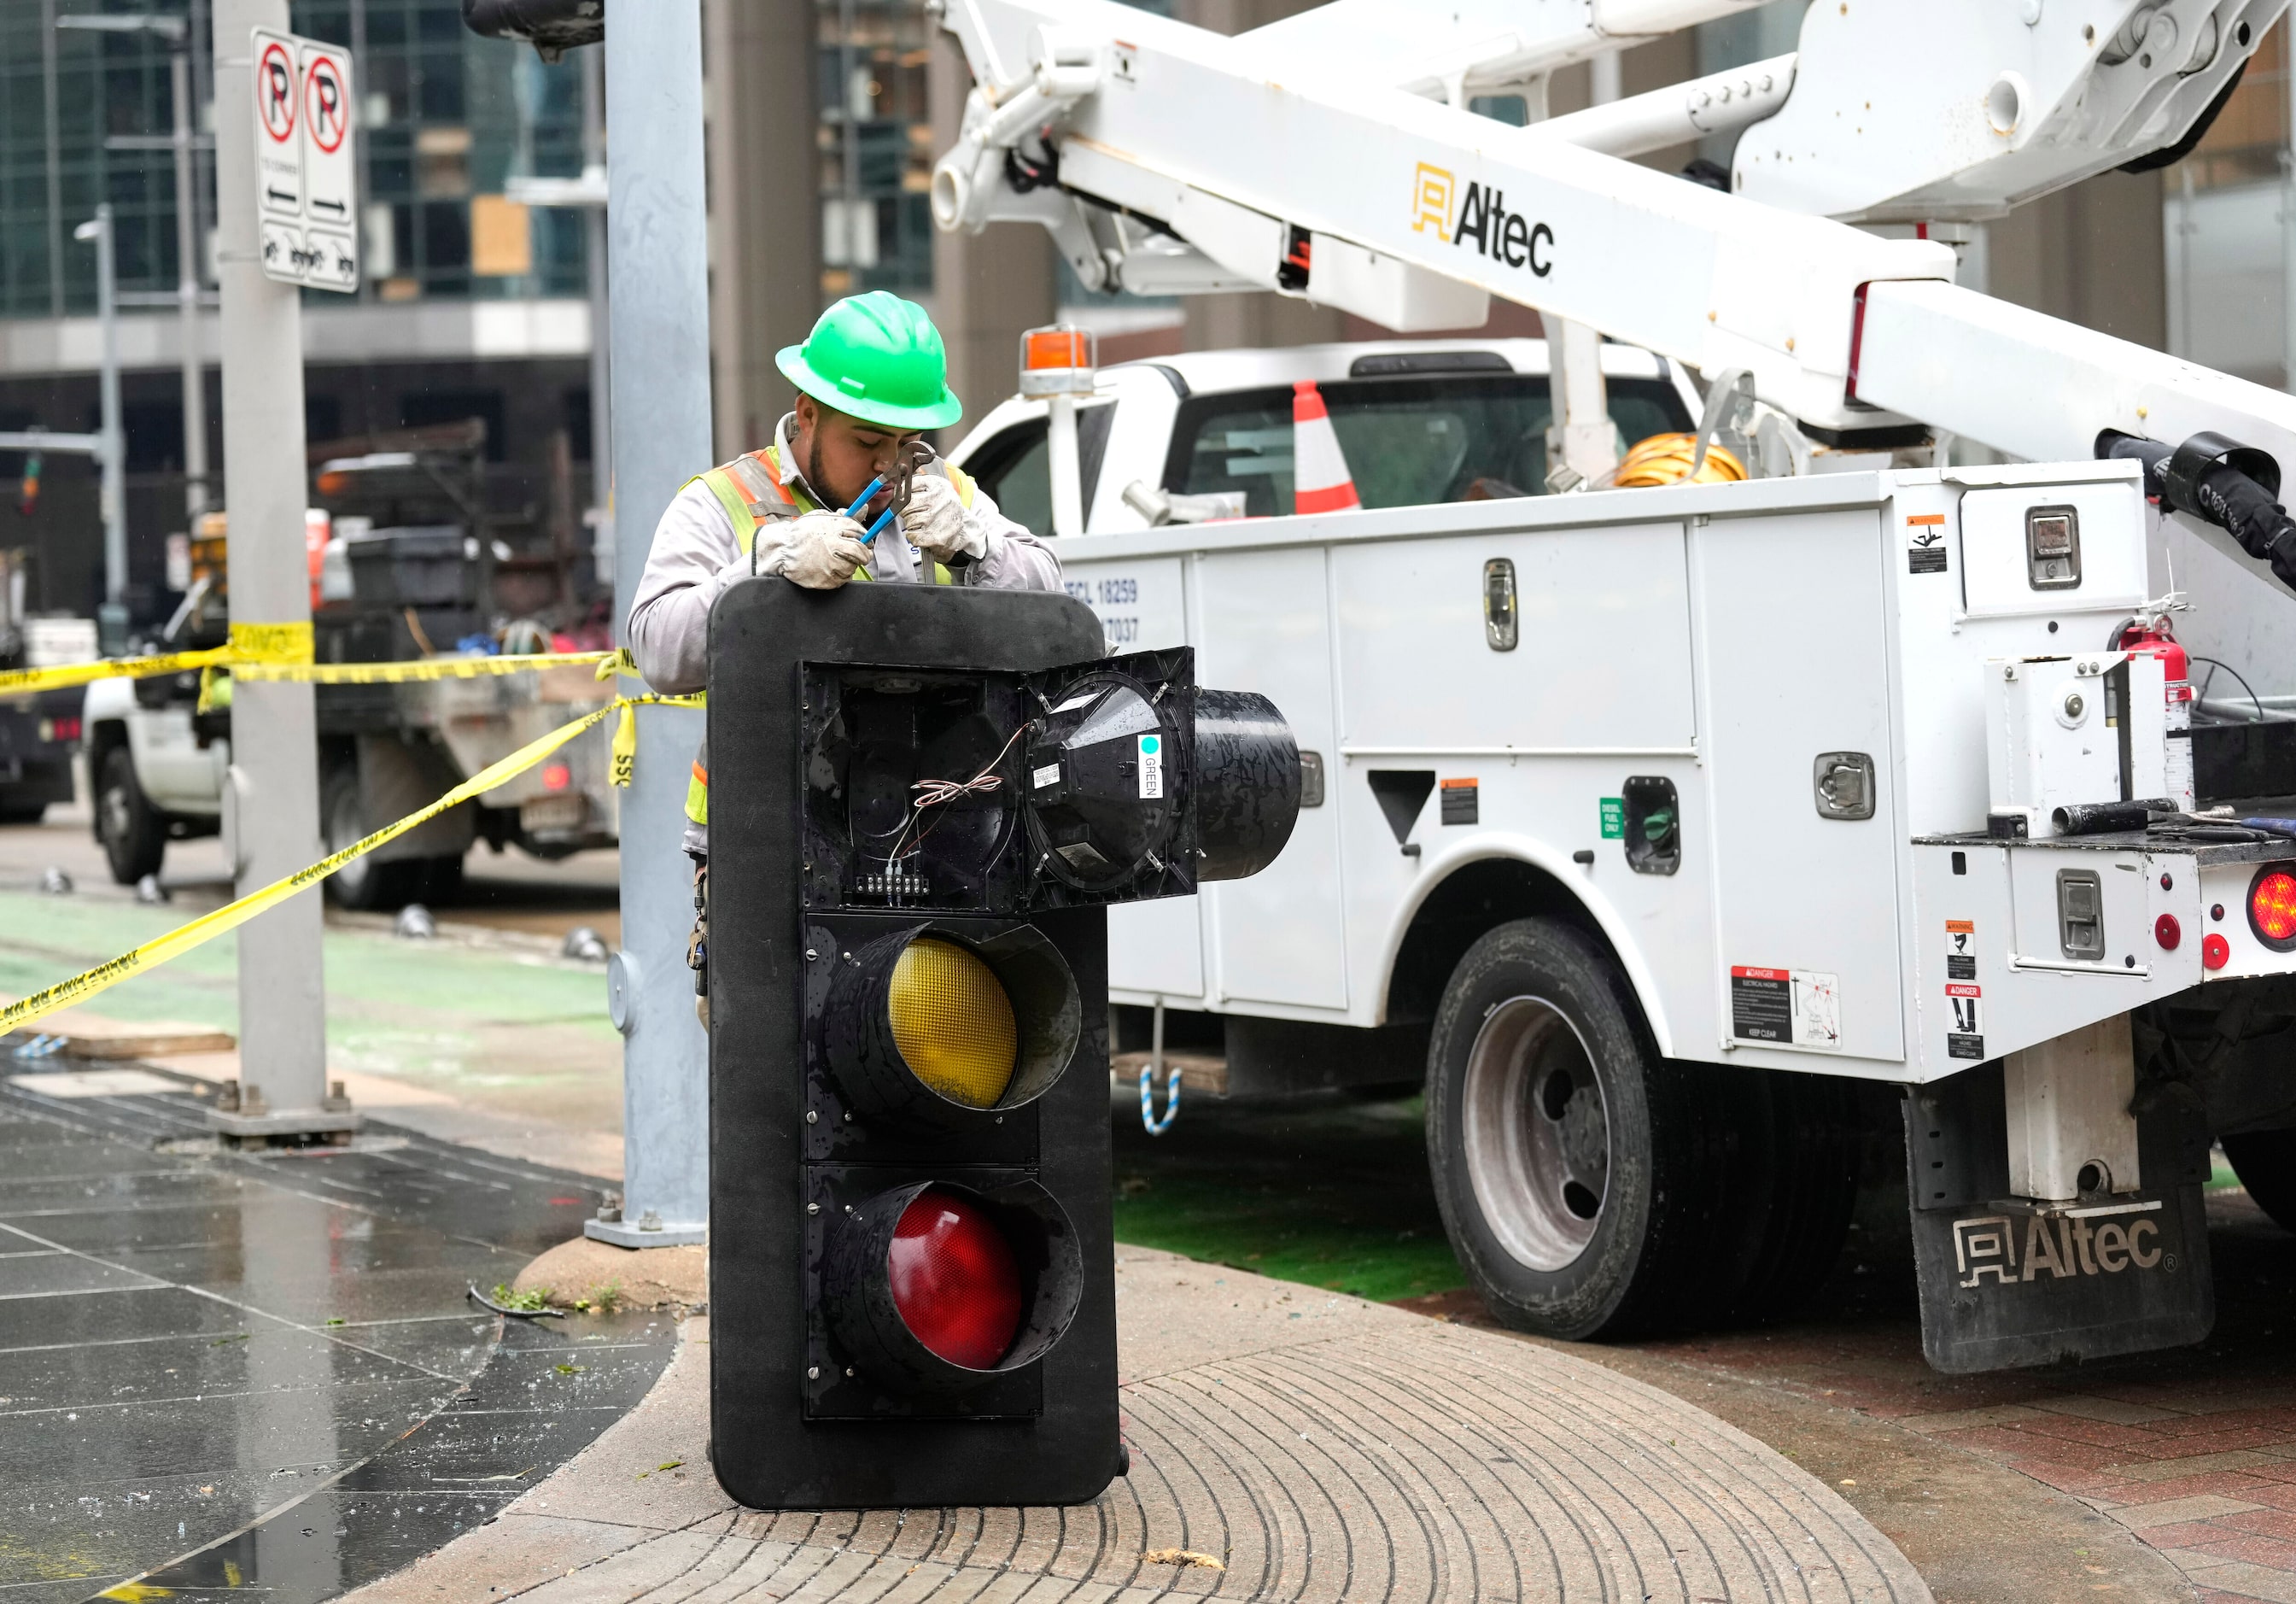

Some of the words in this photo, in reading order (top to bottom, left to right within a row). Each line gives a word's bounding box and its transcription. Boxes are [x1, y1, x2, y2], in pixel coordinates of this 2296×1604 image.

[1453, 180, 1554, 278] Altec
[1098, 578, 1137, 604] 18259
[1145, 758, 1157, 796] GREEN
[1602, 804, 1621, 813] DIESEL
[1604, 813, 1620, 822] FUEL
[1604, 822, 1620, 832] ONLY
[1951, 922, 1973, 931] WARNING
[1750, 969, 1774, 978] DANGER
[1955, 986, 1978, 996] DANGER
[1749, 1028, 1760, 1037] KEEP
[1761, 1029, 1776, 1038] CLEAR
[2022, 1215, 2163, 1282] Altec
